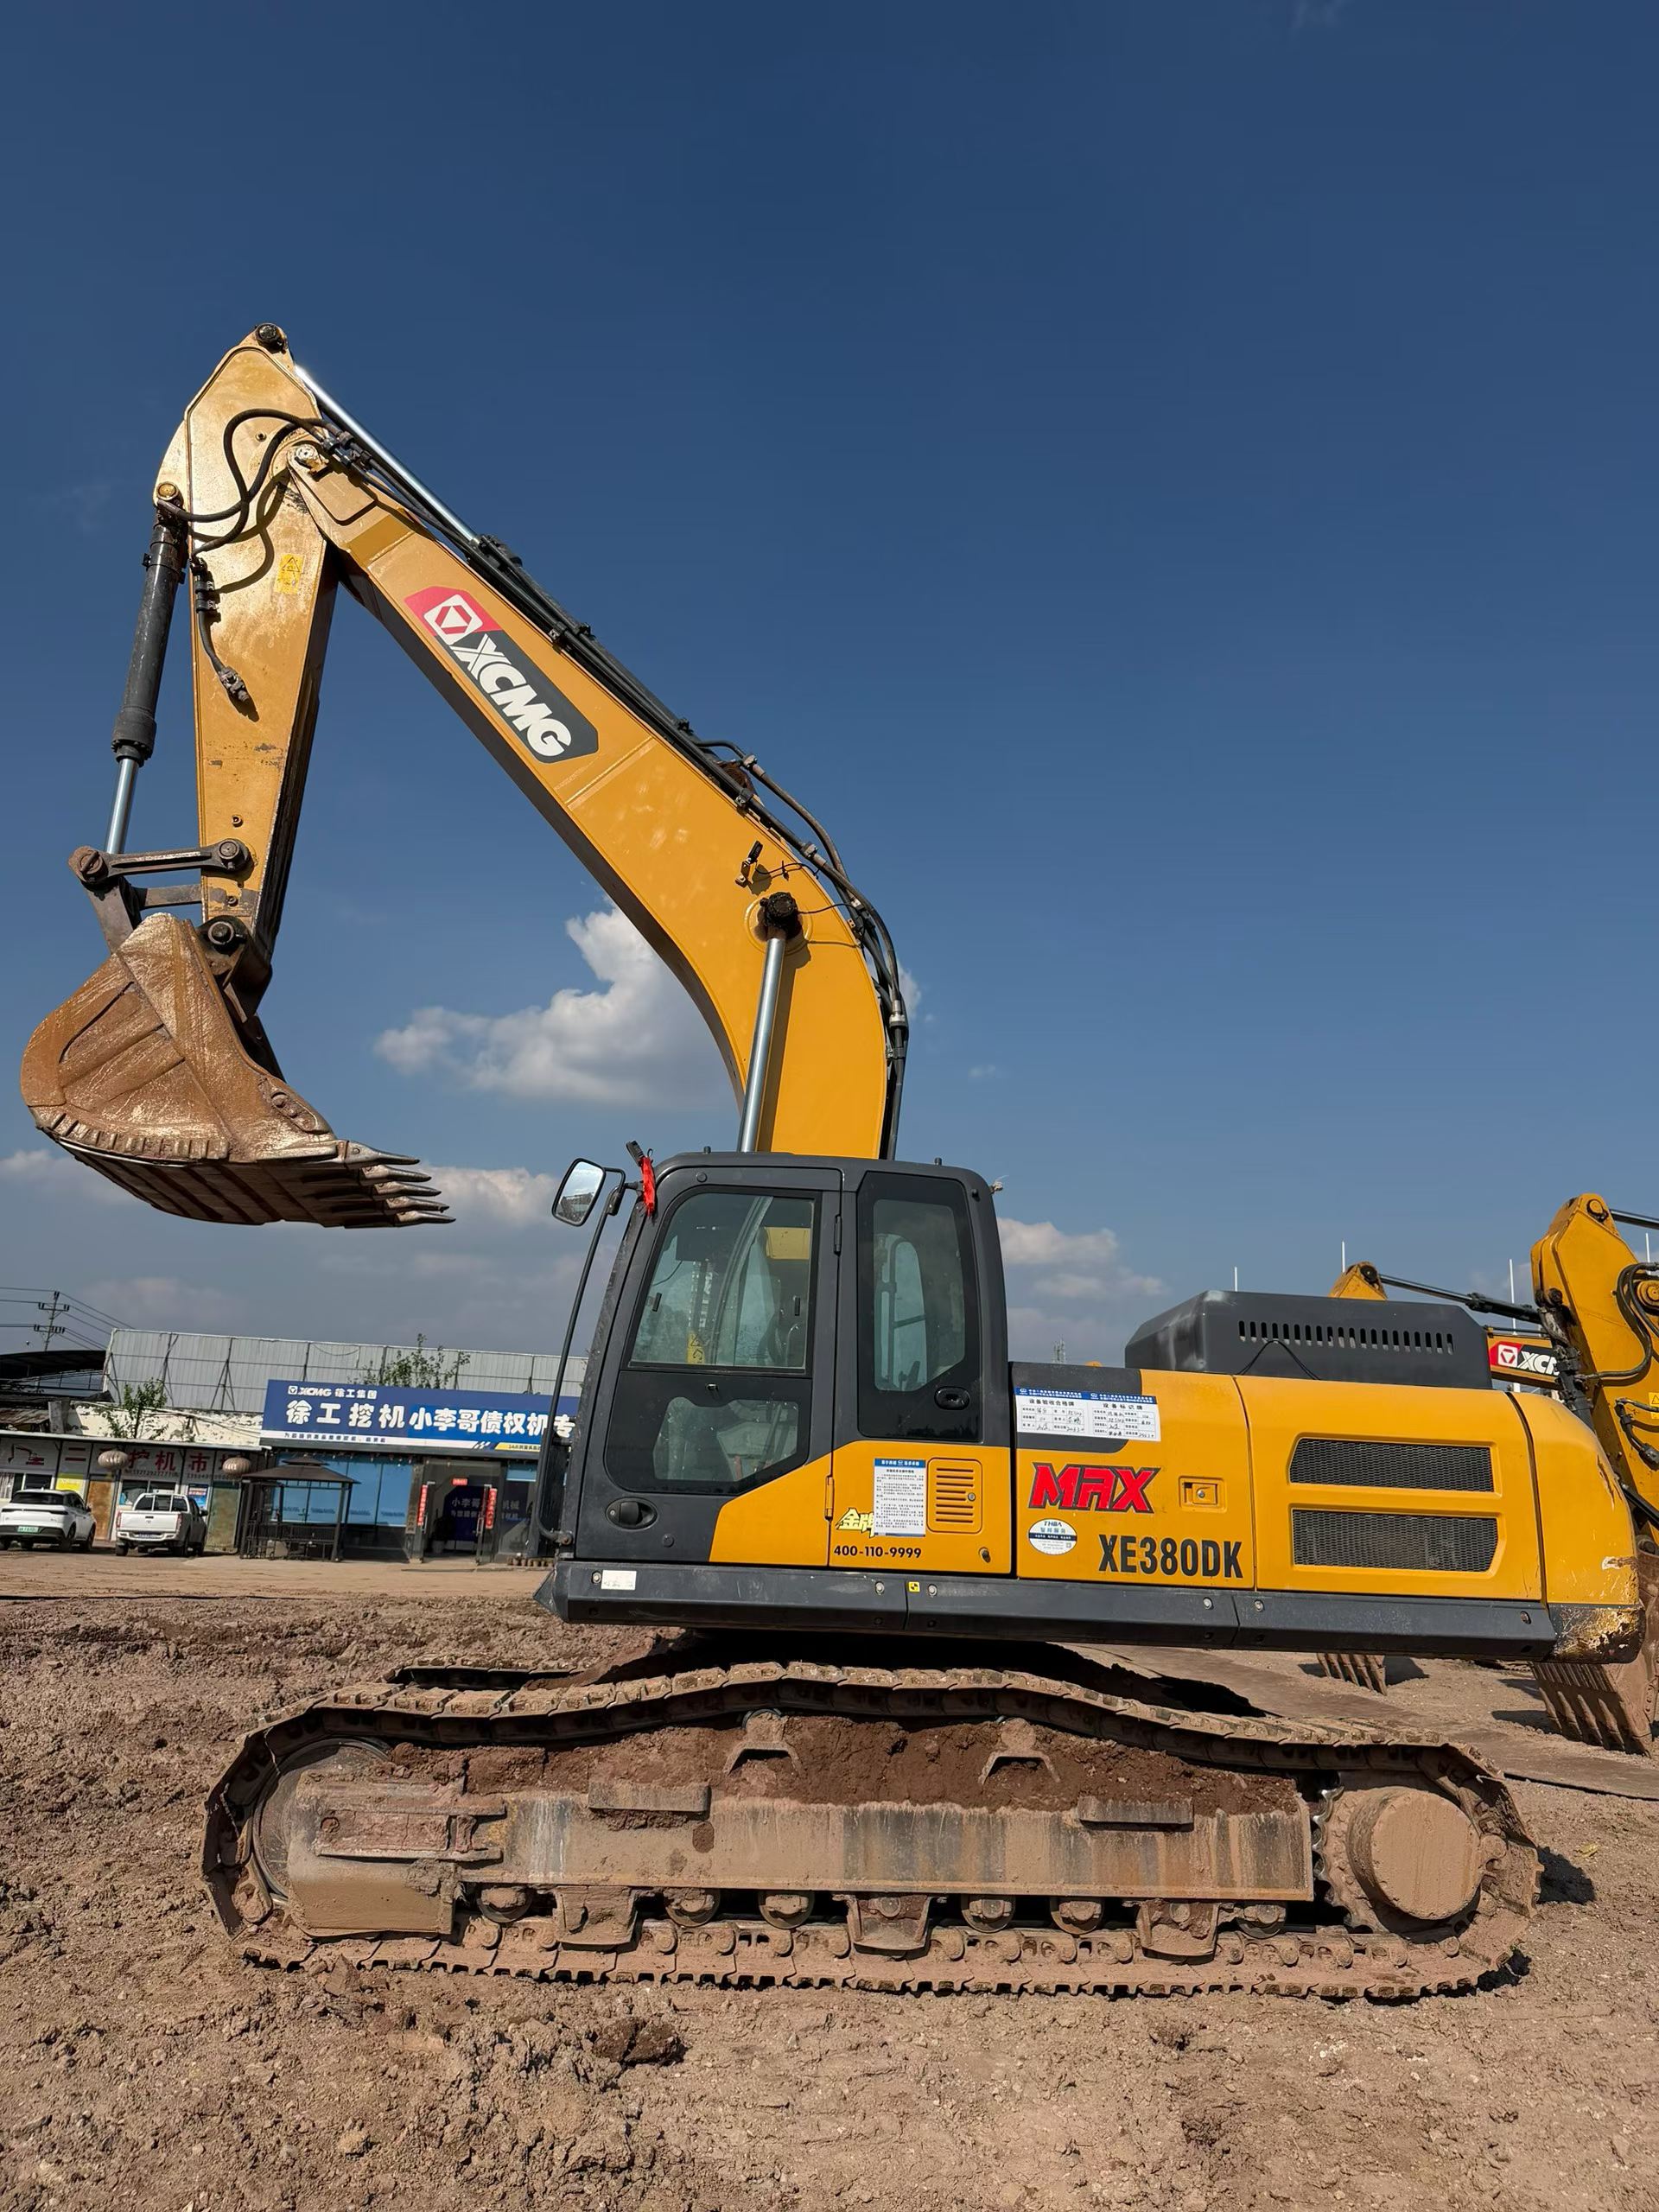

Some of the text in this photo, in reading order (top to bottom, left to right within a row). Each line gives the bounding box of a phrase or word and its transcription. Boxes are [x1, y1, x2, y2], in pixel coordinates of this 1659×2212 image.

[449, 633, 572, 757] XCMG
[298, 1387, 378, 1400] XCMG 徐工集团
[1028, 1462, 1161, 1513] MAX
[834, 1545, 922, 1559] 400-110-9999
[1099, 1534, 1244, 1579] XE380DK
